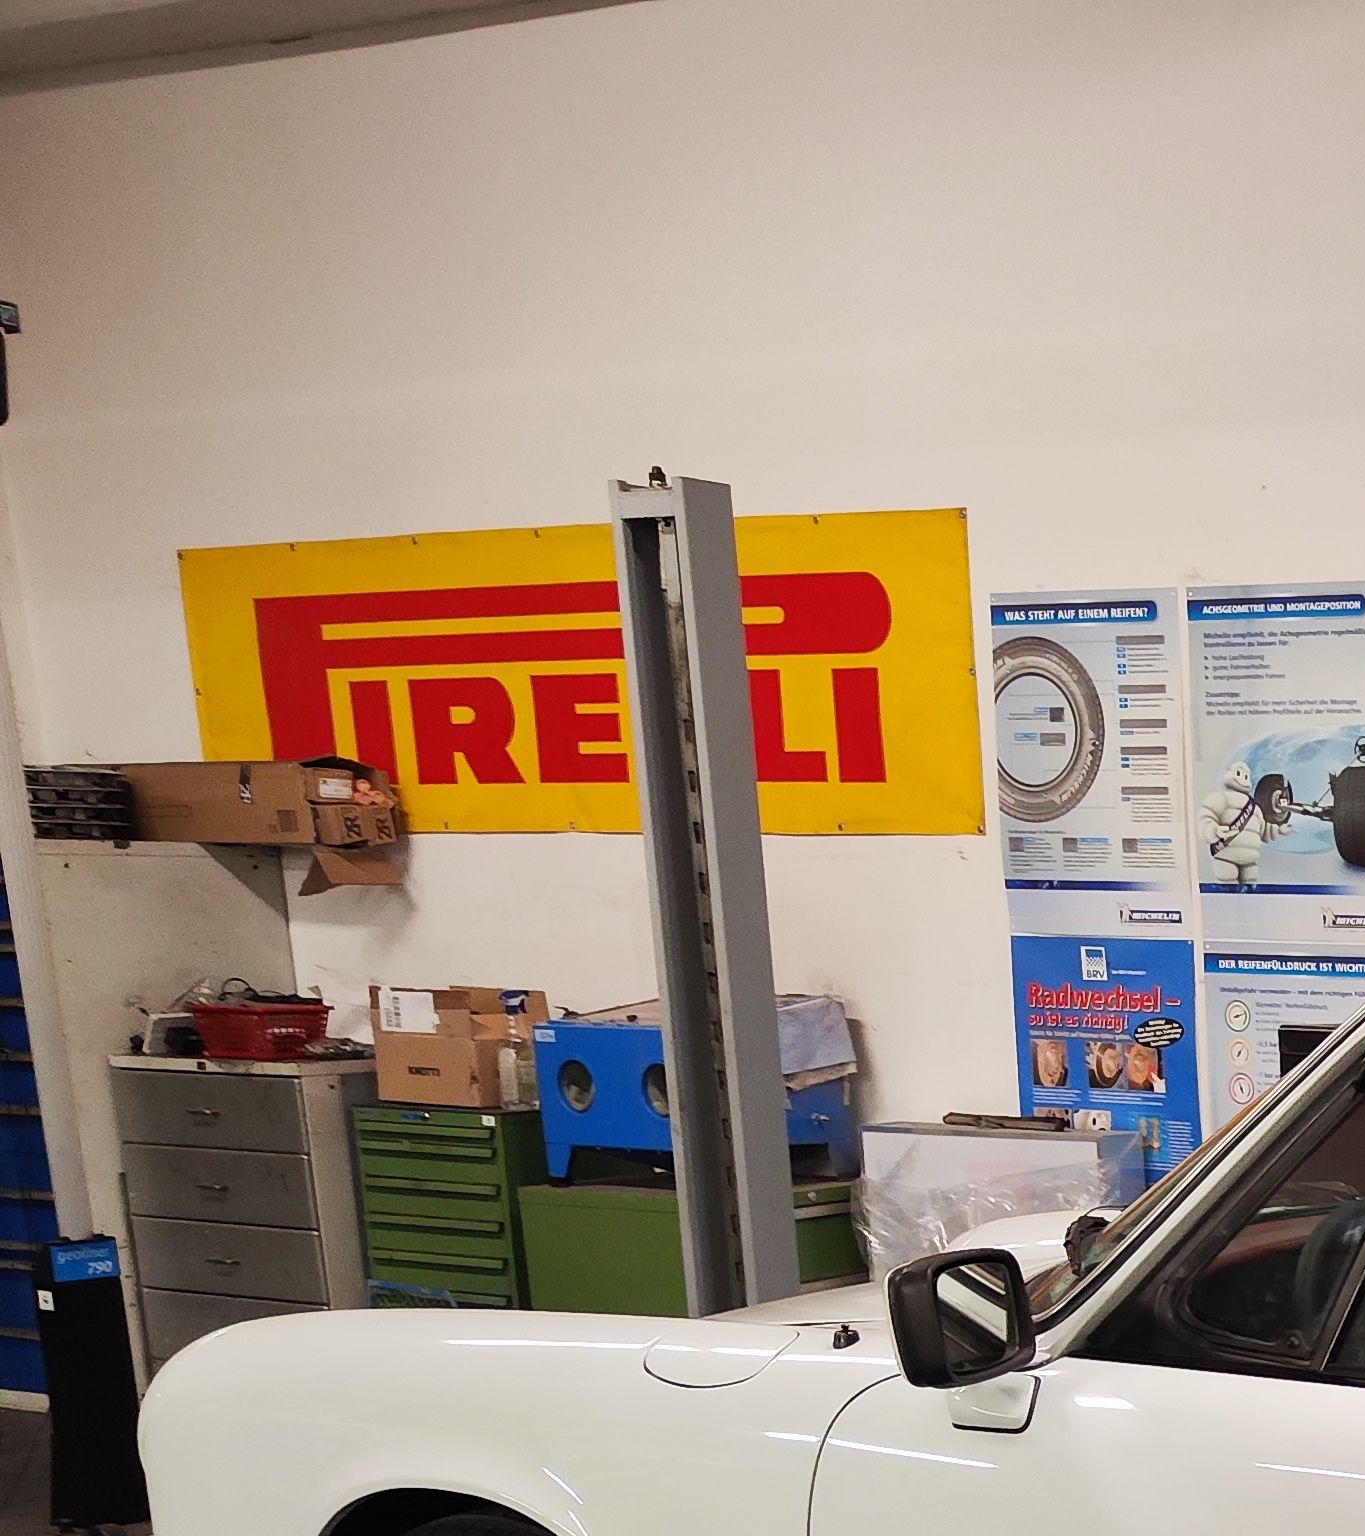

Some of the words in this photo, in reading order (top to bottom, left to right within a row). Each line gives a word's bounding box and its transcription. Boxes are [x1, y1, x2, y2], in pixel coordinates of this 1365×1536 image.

[1267, 602, 1284, 612] UND
[1286, 600, 1361, 611] MONTAGEPOSITION
[1004, 610, 1026, 621] WAS
[1028, 609, 1055, 621] STEHT
[1057, 609, 1076, 620] AUF
[1078, 608, 1109, 619] EINEM
[1111, 607, 1148, 618] REIFEN?
[254, 571, 891, 784] PIRELI
[1132, 911, 1181, 921] MICHELIN
[1218, 959, 1236, 969] DER
[1319, 962, 1333, 972] IST
[1086, 969, 1105, 979] BRV
[1028, 982, 1161, 1013] Radwechsel
[1029, 1014, 1043, 1026] so
[1046, 1012, 1062, 1027] ist
[1066, 1015, 1079, 1028] es
[1081, 1012, 1129, 1034] richtig!
[87, 1260, 113, 1275] 790
